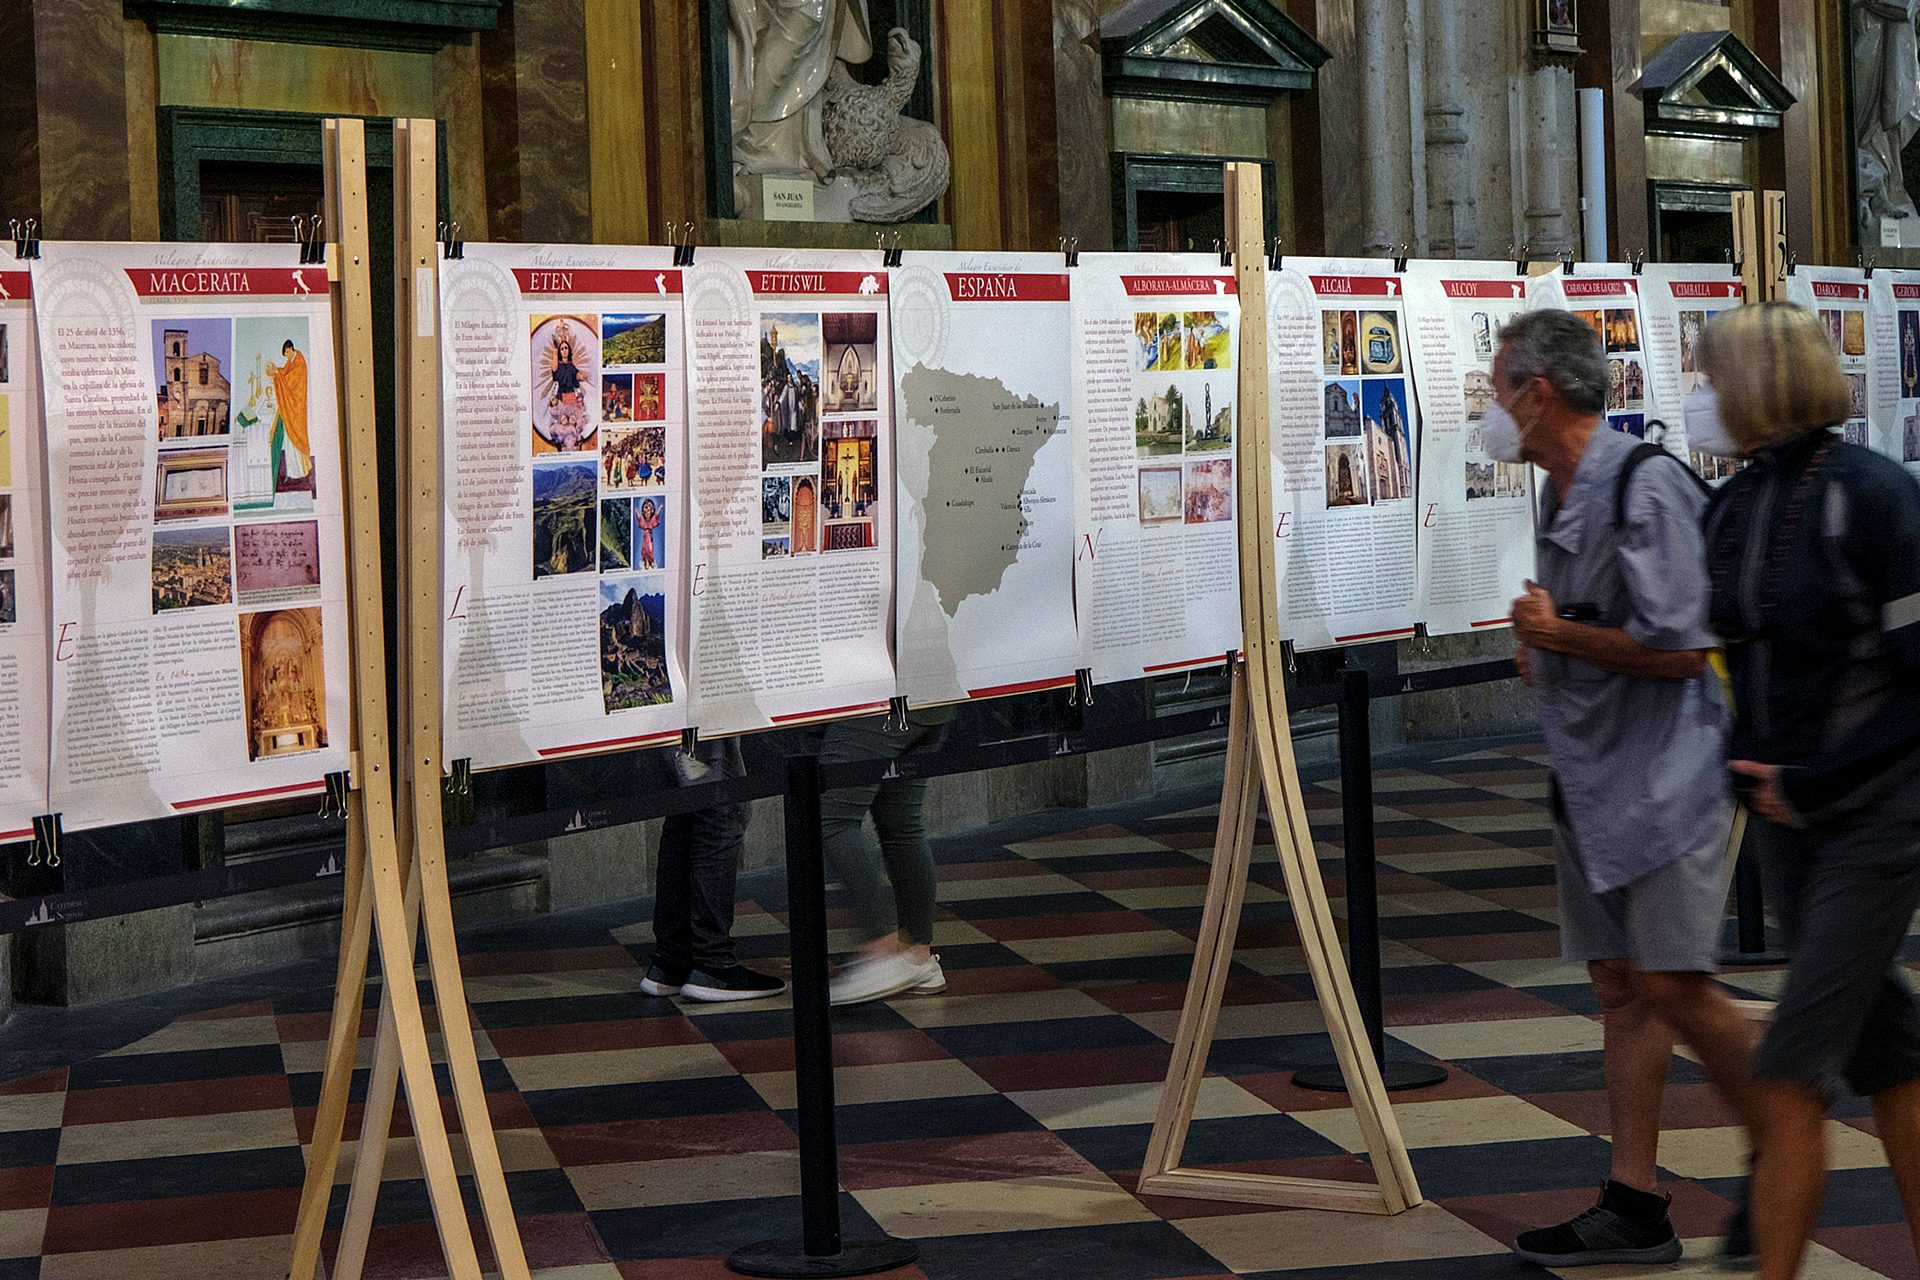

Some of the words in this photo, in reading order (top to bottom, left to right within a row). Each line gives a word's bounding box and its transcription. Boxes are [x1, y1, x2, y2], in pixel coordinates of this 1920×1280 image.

[773, 192, 785, 200] SAN
[787, 193, 803, 201] JUAN
[153, 250, 190, 266] Milagro
[531, 252, 562, 269] Milagro
[762, 255, 790, 270] Milagro
[958, 258, 982, 272] Milagro
[150, 272, 250, 293] MACERATA
[530, 273, 573, 290] ETEN
[761, 274, 827, 291] ETTISWIL
[958, 273, 1017, 297] ESPAÑA
[1133, 278, 1210, 291] ALBORAYA-ALMÁCERA
[1320, 277, 1351, 293] ALCALÁ
[1451, 283, 1477, 296] ALCOY
[1566, 283, 1592, 293] CARAVACA
[1593, 283, 1600, 293] DE
[1600, 283, 1607, 292] LA
[1608, 283, 1621, 292] CRUZ
[1676, 284, 1710, 296] CIMBALLA
[1816, 284, 1841, 296] DAROCA
[461, 321, 480, 331] Milagro
[58, 328, 64, 336] El
[66, 328, 73, 336] 25
[76, 328, 83, 336] de
[85, 328, 97, 336] abril
[61, 357, 75, 365] cuyo
[76, 354, 98, 362] nombre
[81, 368, 113, 376] celebrando
[114, 367, 119, 375] la
[121, 367, 135, 375] Misa
[72, 382, 77, 390] la
[104, 380, 111, 388] de
[113, 380, 118, 388] la
[119, 381, 136, 391] iglesia
[138, 380, 145, 388] de
[469, 381, 484, 389] Hostia
[111, 394, 139, 404] propiedad
[141, 393, 148, 401] de
[66, 408, 74, 417] las
[76, 409, 97, 418] monjas
[137, 406, 145, 414] En
[147, 406, 152, 414] el
[1001, 403, 1010, 411] Juan
[98, 421, 105, 429] de
[107, 421, 112, 429] la
[113, 420, 136, 429] fracción
[137, 419, 146, 427] del
[100, 434, 107, 442] de
[108, 434, 113, 442] la
[70, 449, 95, 457] comenzó
[102, 447, 118, 456] dudar
[119, 447, 127, 455] de
[128, 447, 133, 455] la
[69, 462, 95, 473] presencia
[97, 461, 107, 470] real
[108, 461, 116, 469] de
[116, 460, 130, 470] Jesús
[140, 459, 145, 467] la
[69, 475, 87, 484] Hostia
[123, 473, 133, 482] Fue
[952, 499, 974, 508] Guadalupe
